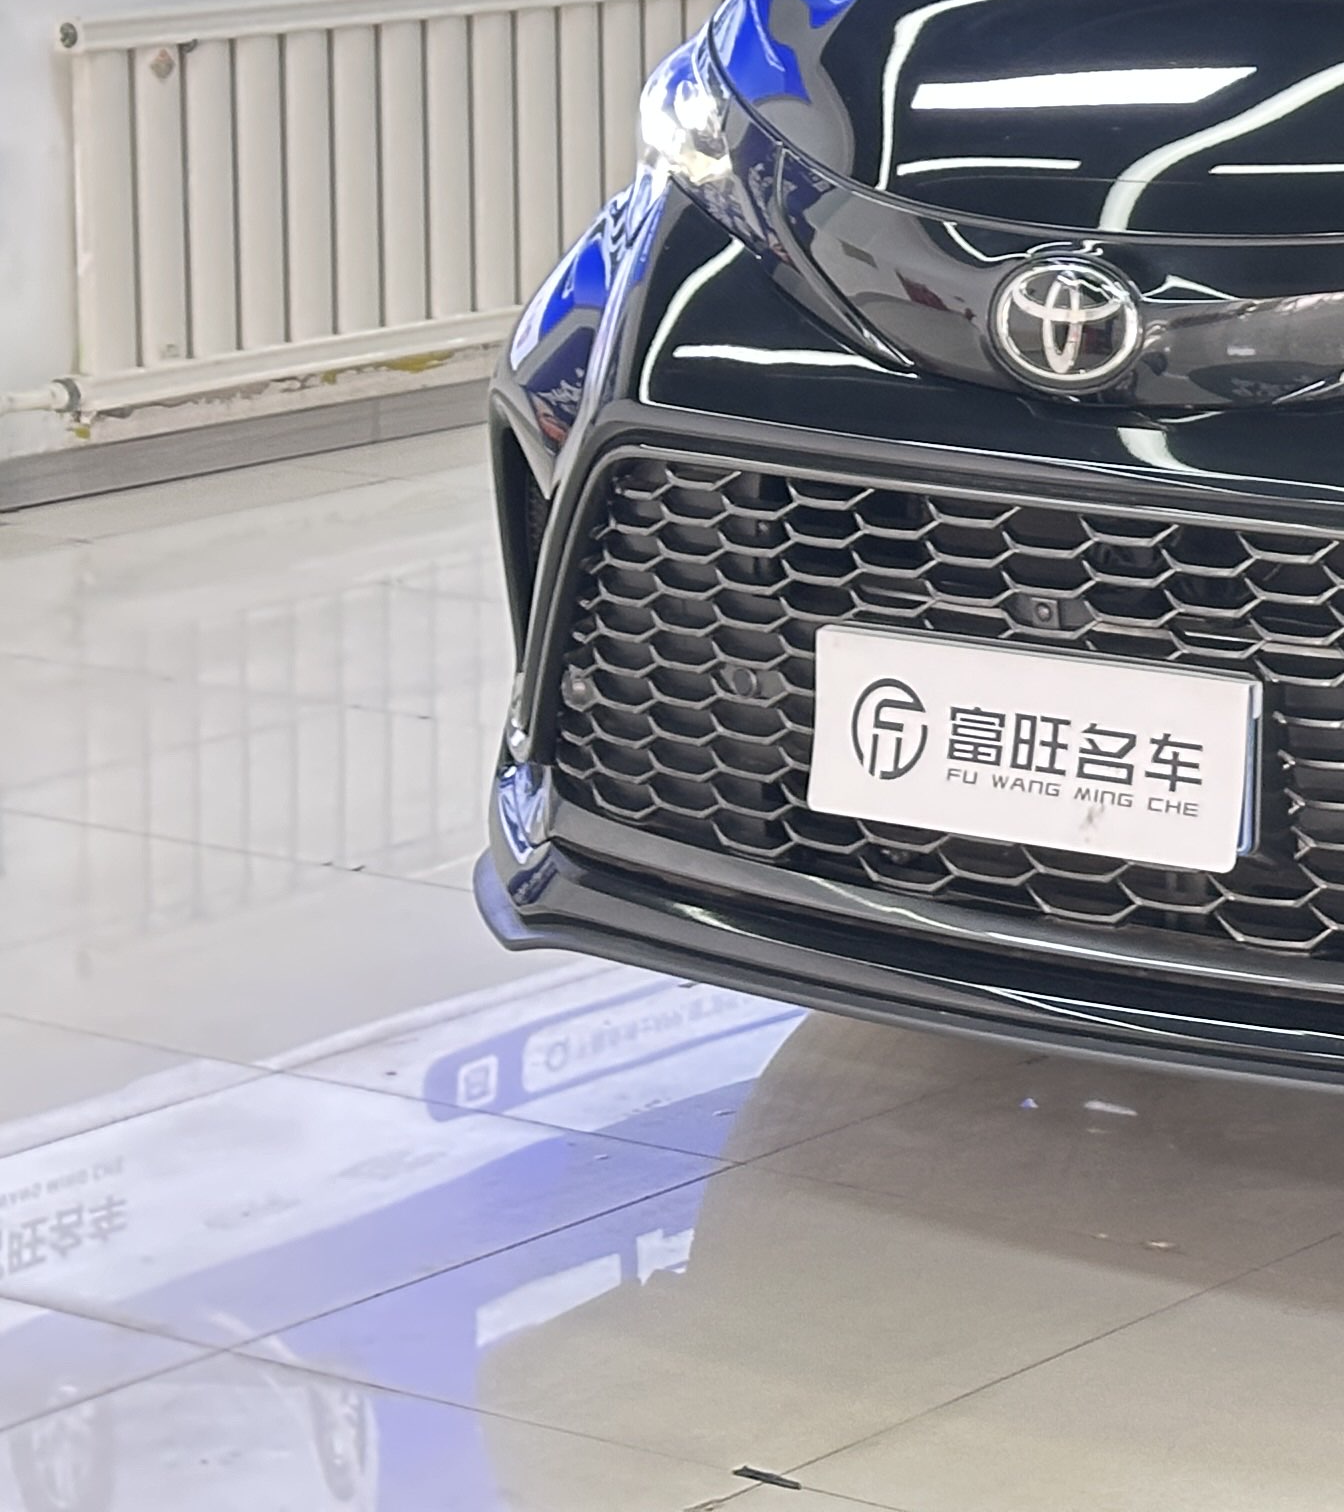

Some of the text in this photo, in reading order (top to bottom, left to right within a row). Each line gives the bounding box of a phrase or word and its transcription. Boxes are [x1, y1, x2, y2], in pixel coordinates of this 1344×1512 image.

[946, 705, 1205, 793] 富旺名车
[946, 768, 1200, 818] FU WANG MING CHE
